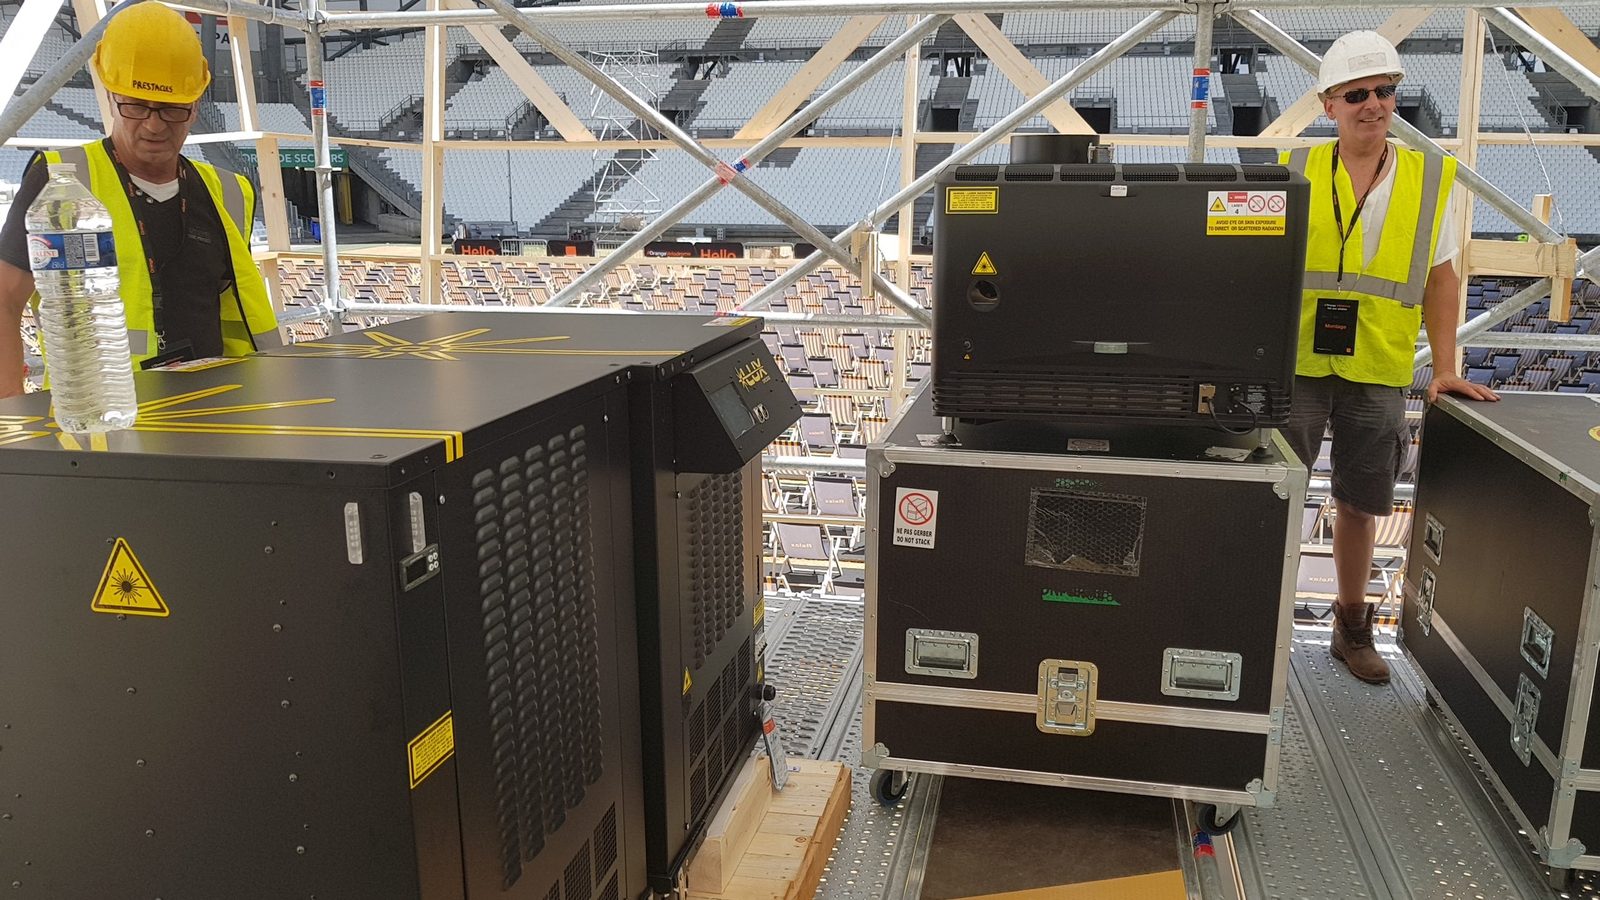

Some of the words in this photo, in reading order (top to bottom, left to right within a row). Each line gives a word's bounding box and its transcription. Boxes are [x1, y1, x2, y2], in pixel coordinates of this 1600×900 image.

[294, 154, 344, 163] SECRS
[461, 245, 495, 255] Hello
[700, 248, 736, 258] Hello
[913, 529, 932, 537] GERBER
